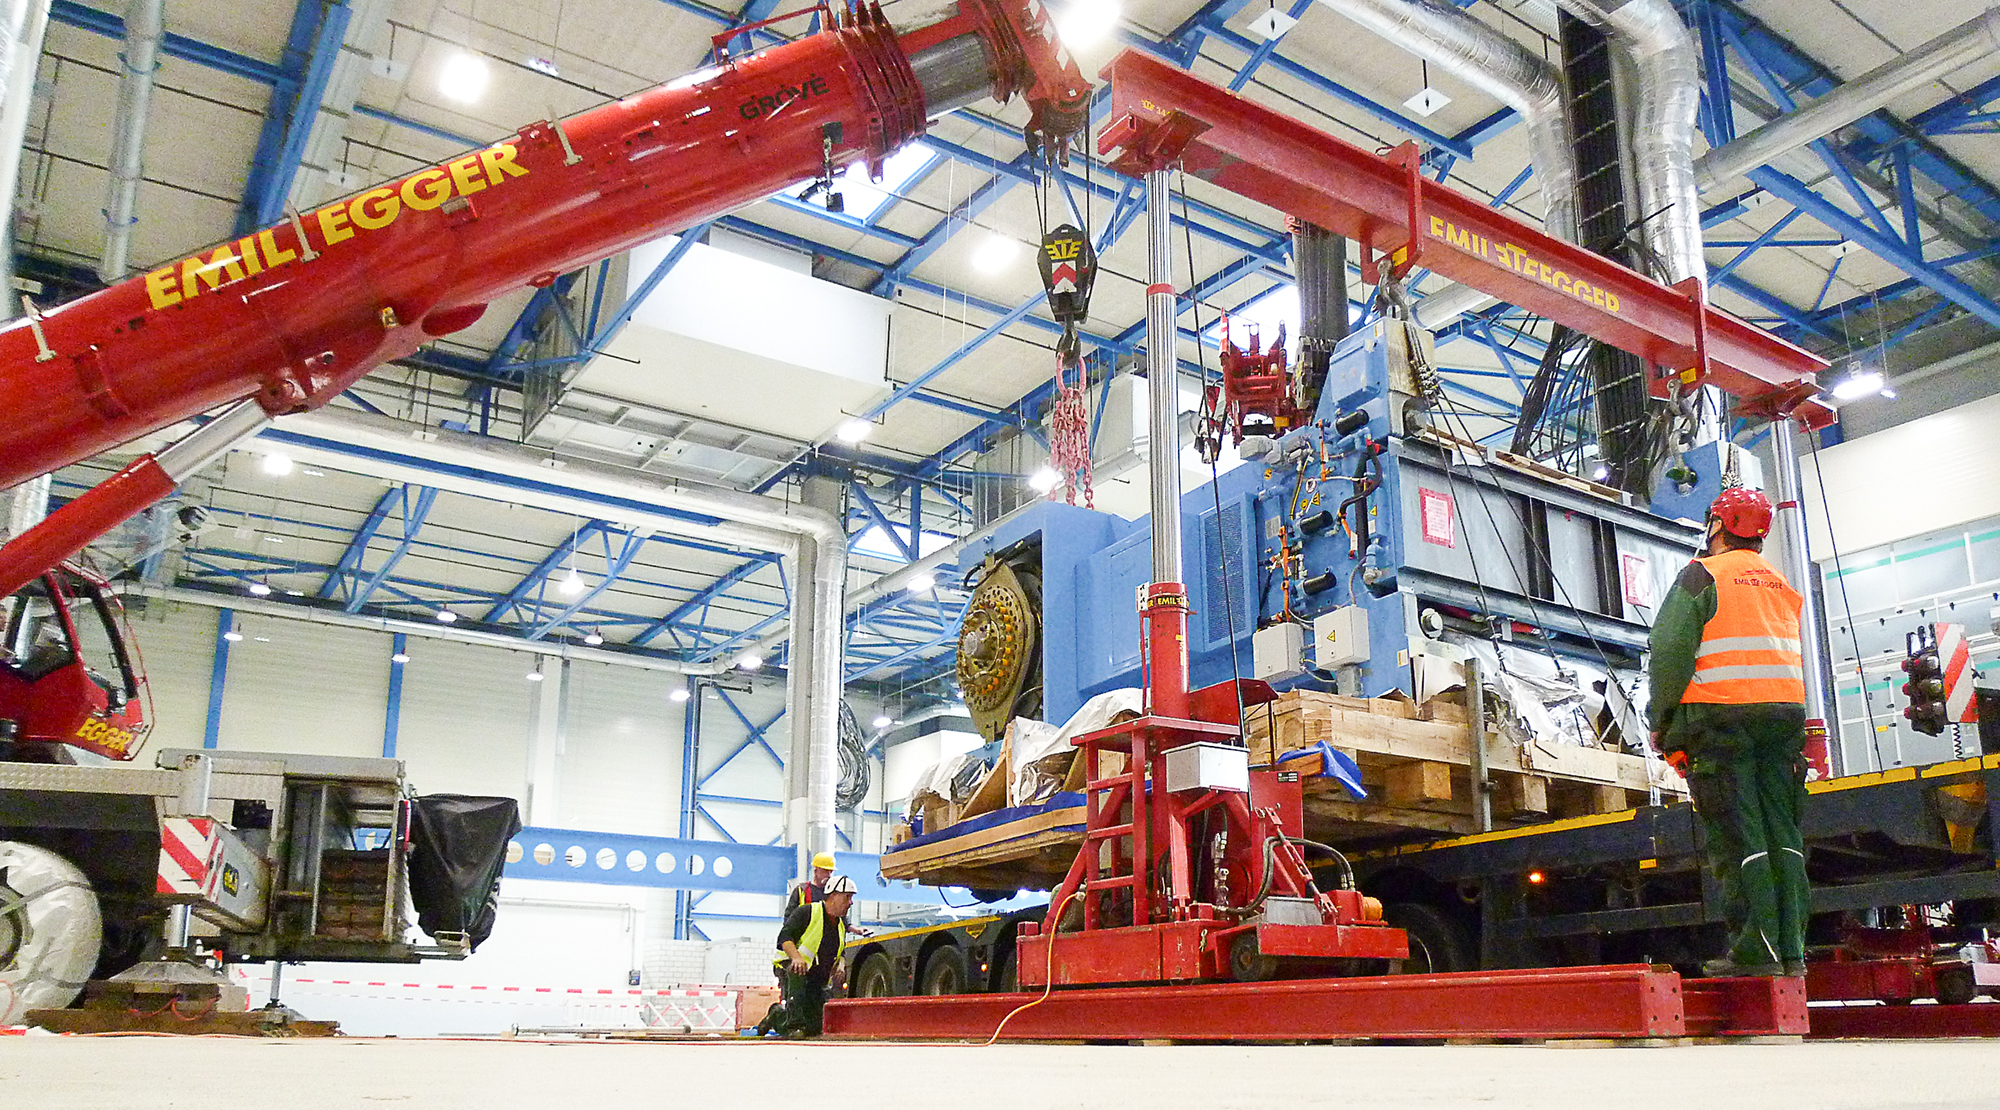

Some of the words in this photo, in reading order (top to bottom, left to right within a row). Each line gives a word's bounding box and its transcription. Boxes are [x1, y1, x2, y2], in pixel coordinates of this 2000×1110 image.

[740, 77, 830, 120] GROVE
[145, 228, 297, 311] EMIL
[316, 143, 531, 246] EGGER
[1157, 597, 1177, 605] EMIL
[76, 717, 133, 753] EGGER
